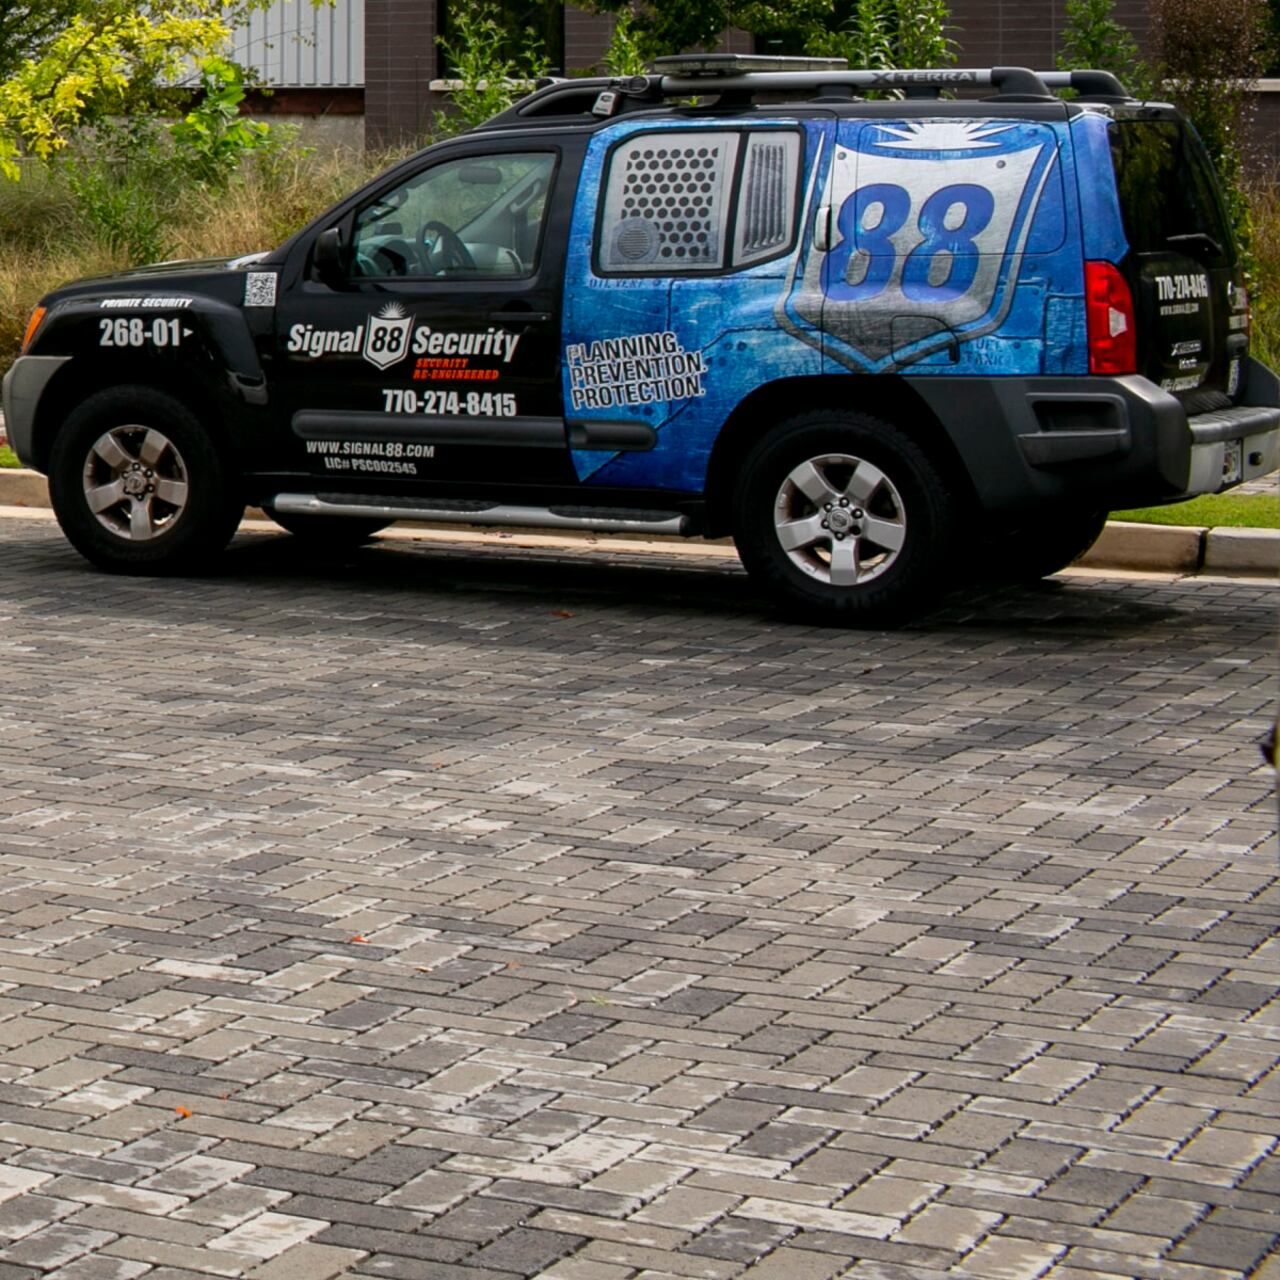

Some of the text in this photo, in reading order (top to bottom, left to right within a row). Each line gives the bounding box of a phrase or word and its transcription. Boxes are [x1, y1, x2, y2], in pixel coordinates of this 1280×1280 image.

[819, 183, 995, 304] 88
[101, 299, 193, 308] PRIVATE SECURITY
[99, 318, 180, 347] 268-01
[288, 323, 520, 363] Signal 88 Security
[416, 358, 470, 368] SECURITY
[566, 331, 684, 367] PLANNING.
[412, 369, 500, 380] RE-ENGINEERED
[570, 351, 708, 388] PREVENTION.
[382, 389, 518, 418] 770-274-8415
[571, 374, 706, 412] PROTECTION.
[306, 441, 435, 458] WWW.SIGNAL88.COM
[324, 456, 418, 476] LIC# PSC002545
